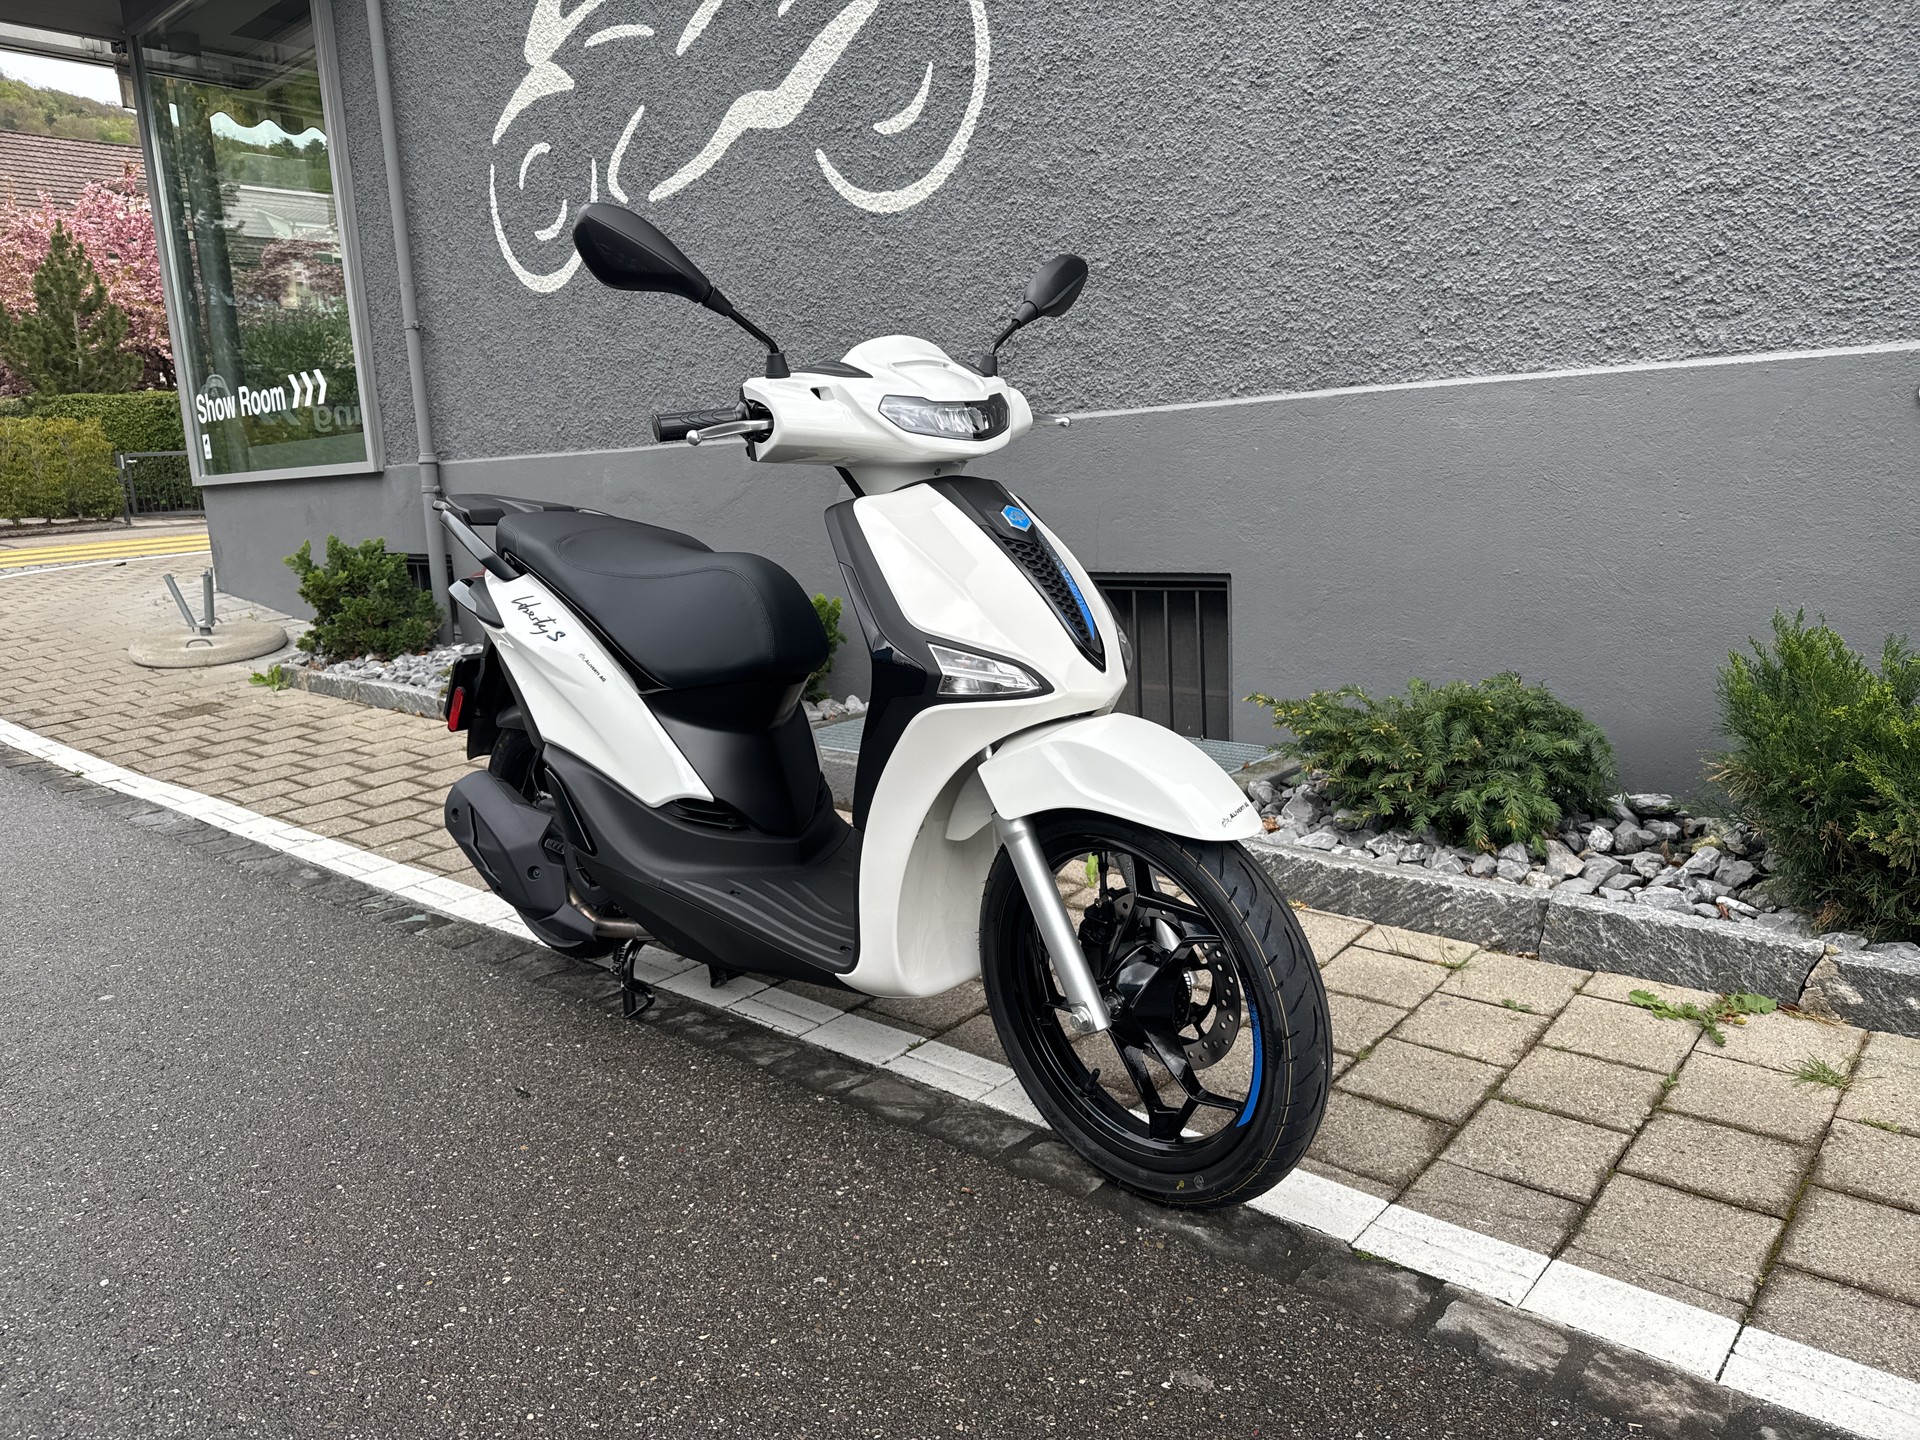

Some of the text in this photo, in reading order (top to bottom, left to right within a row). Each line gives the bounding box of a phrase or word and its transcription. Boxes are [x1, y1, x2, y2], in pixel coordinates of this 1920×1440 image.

[196, 386, 287, 424] Show Room
[511, 595, 566, 642] Liberty S
